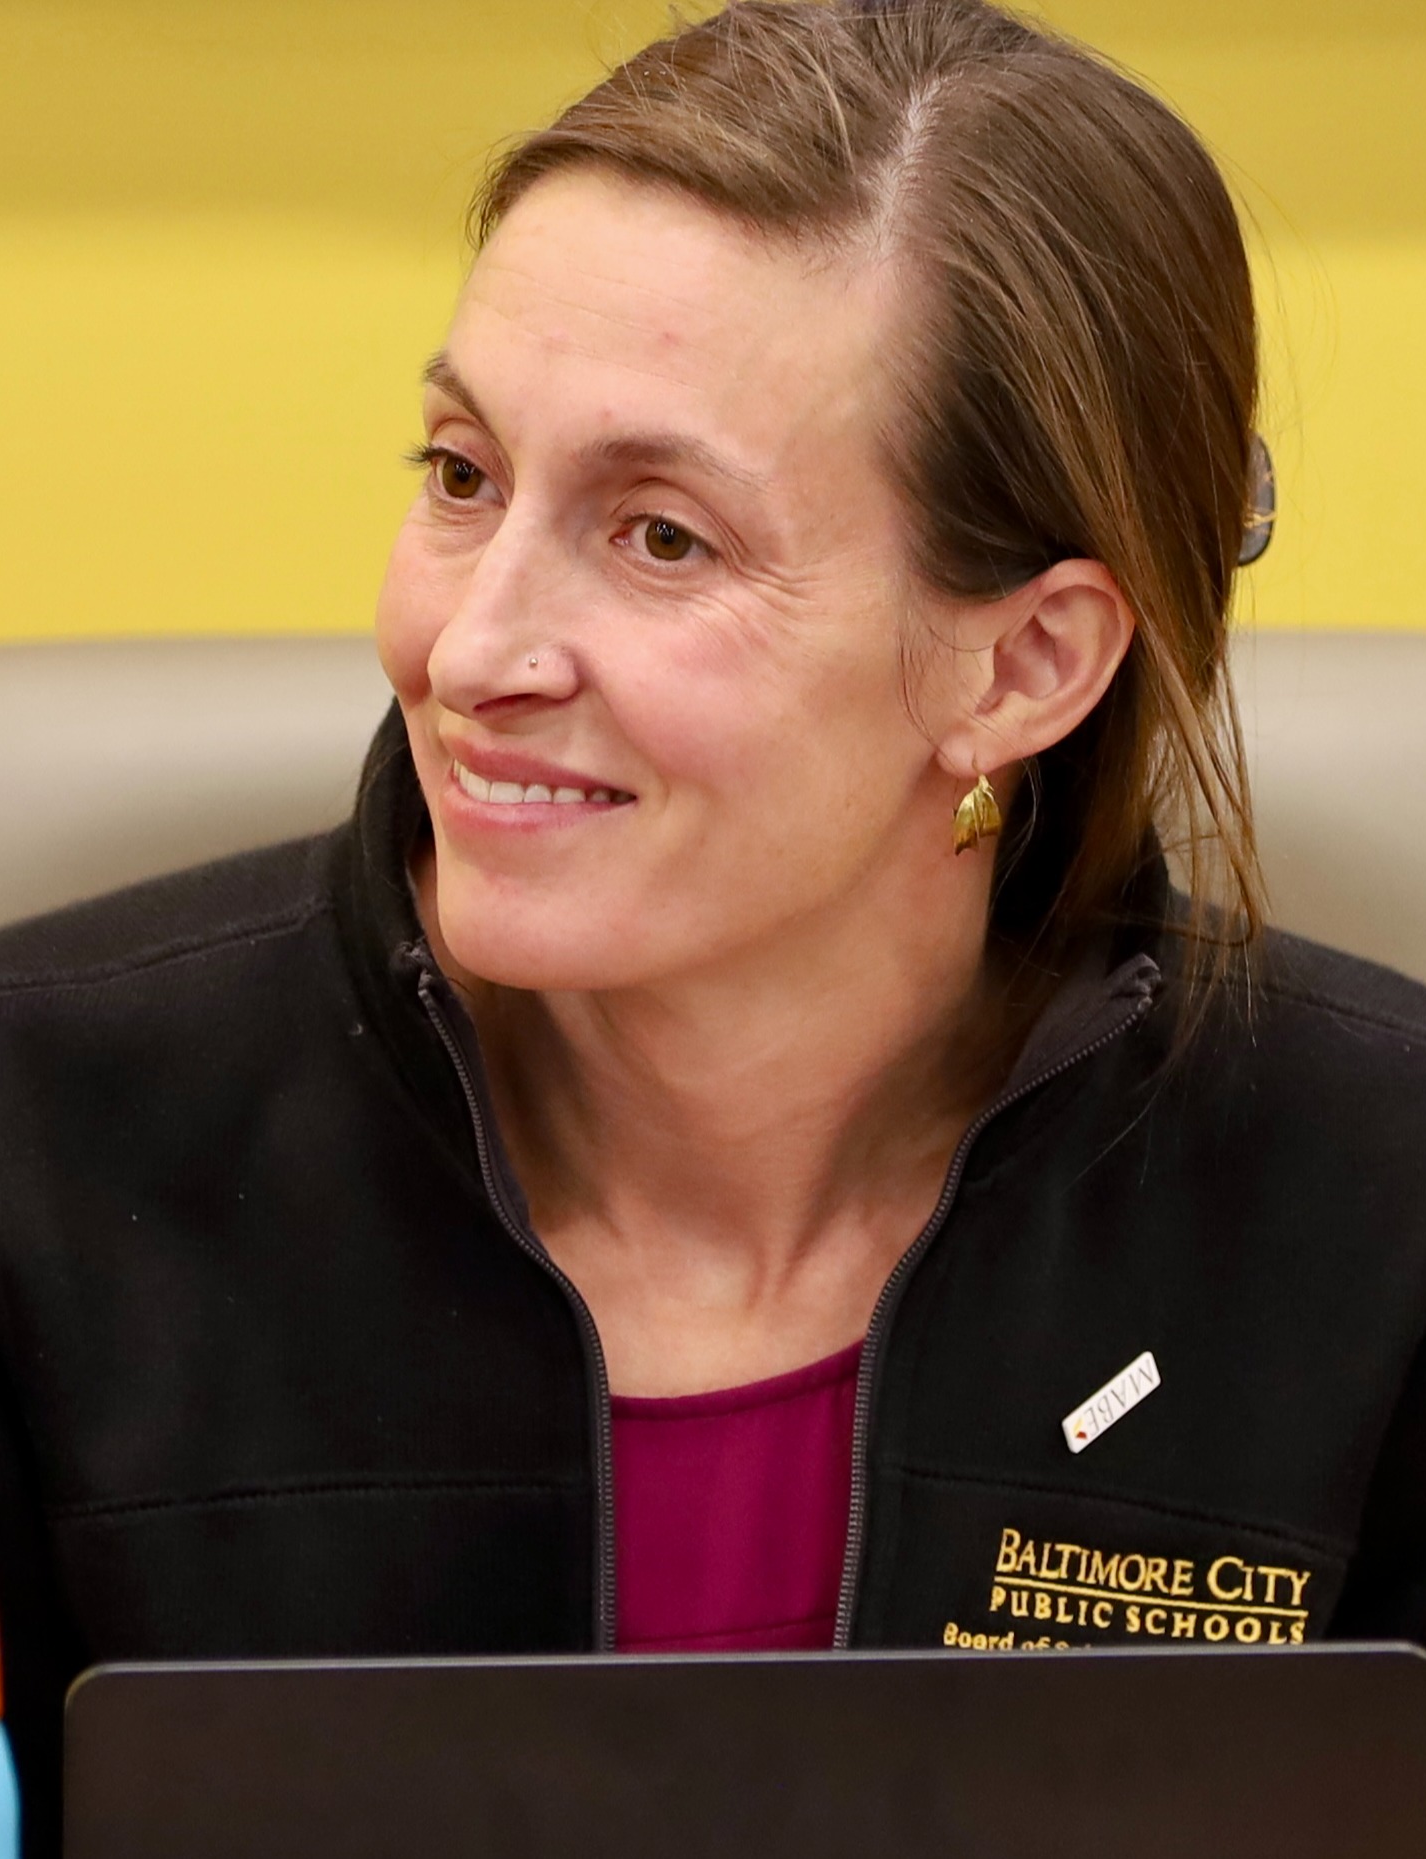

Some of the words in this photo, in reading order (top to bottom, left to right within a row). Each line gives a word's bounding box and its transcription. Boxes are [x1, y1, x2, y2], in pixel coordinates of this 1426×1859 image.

[1083, 1358, 1154, 1437] MABE
[995, 1527, 1194, 1597] BALTIMORE
[1207, 1556, 1311, 1606] CITY
[943, 1622, 1015, 1651] Board
[989, 1586, 1114, 1629] PUBLIC
[1125, 1606, 1306, 1645] SCHOOLS
